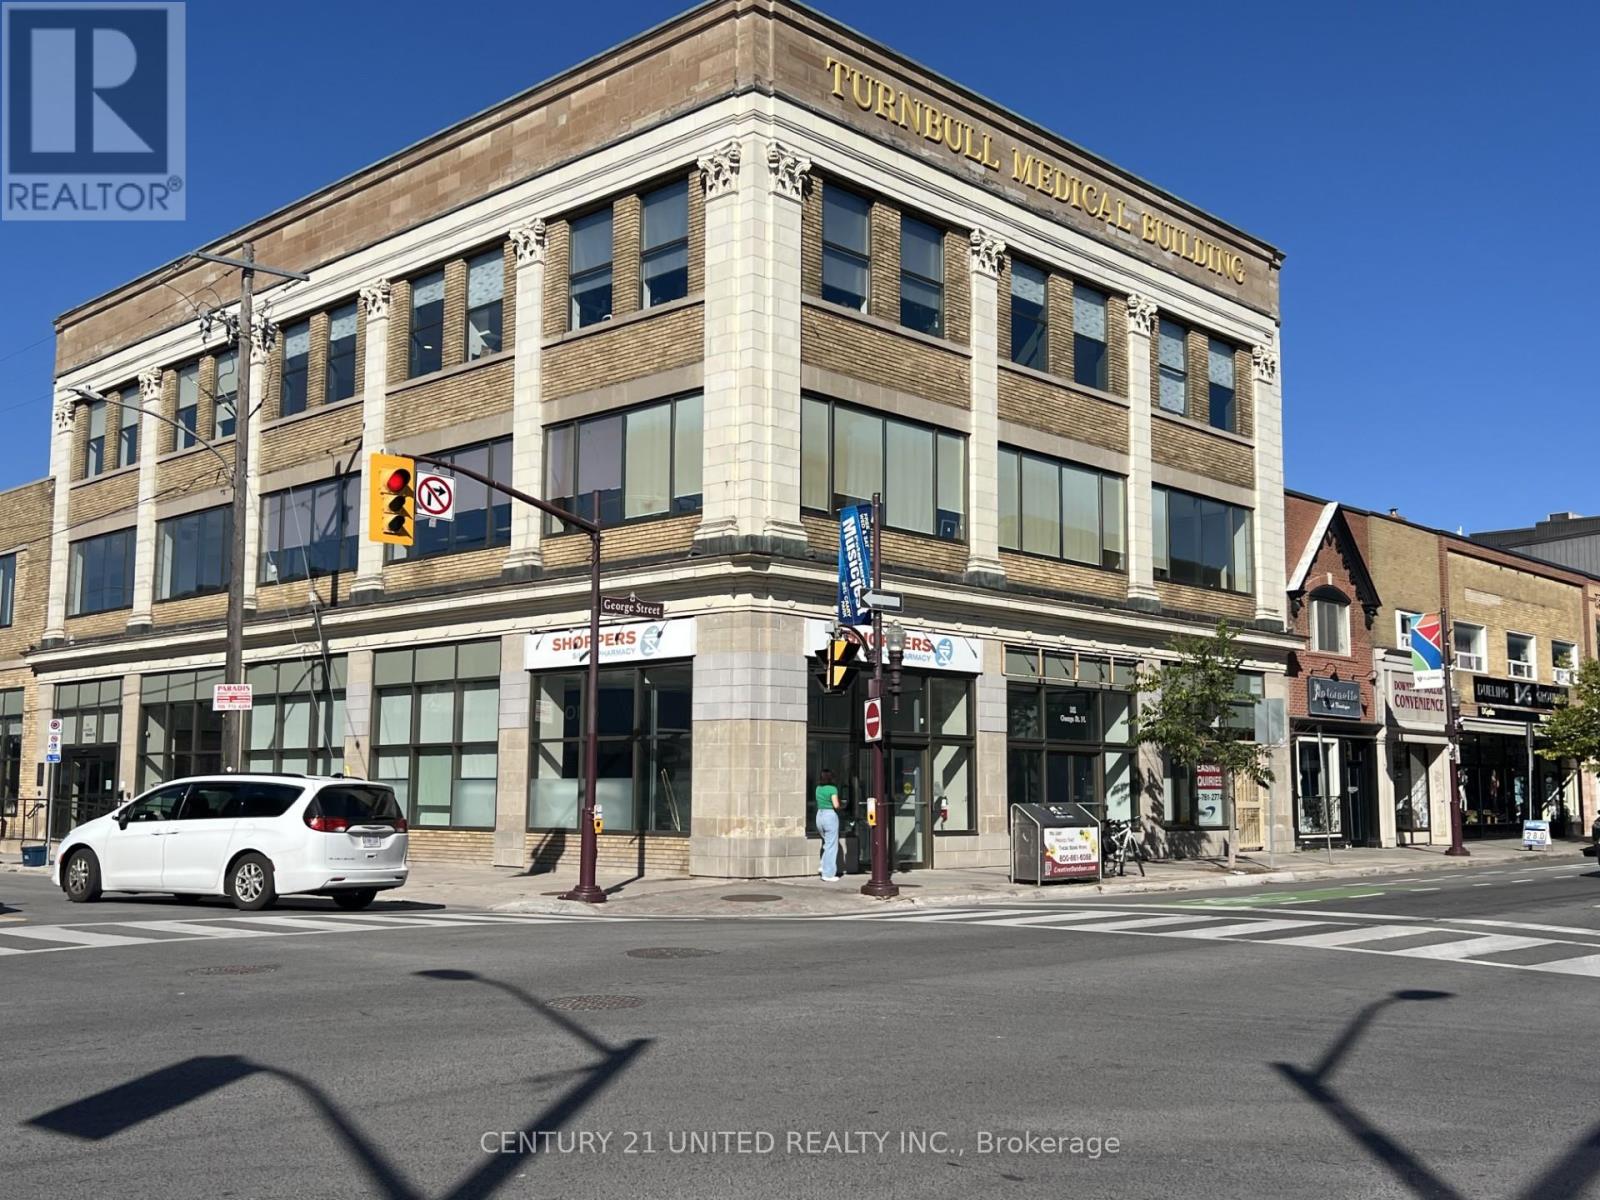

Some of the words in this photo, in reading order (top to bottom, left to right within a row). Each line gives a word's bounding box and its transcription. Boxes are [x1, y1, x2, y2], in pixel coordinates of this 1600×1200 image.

[826, 56, 1000, 171] TURNBULL
[1011, 147, 1132, 234] MEDICAL
[1142, 210, 1247, 284] BUILDING
[603, 599, 634, 615] George
[635, 602, 661, 615] Street
[1394, 694, 1445, 712] CONVENIENCE
[1196, 764, 1221, 773] EASING
[1196, 775, 1224, 787] QUIRIES
